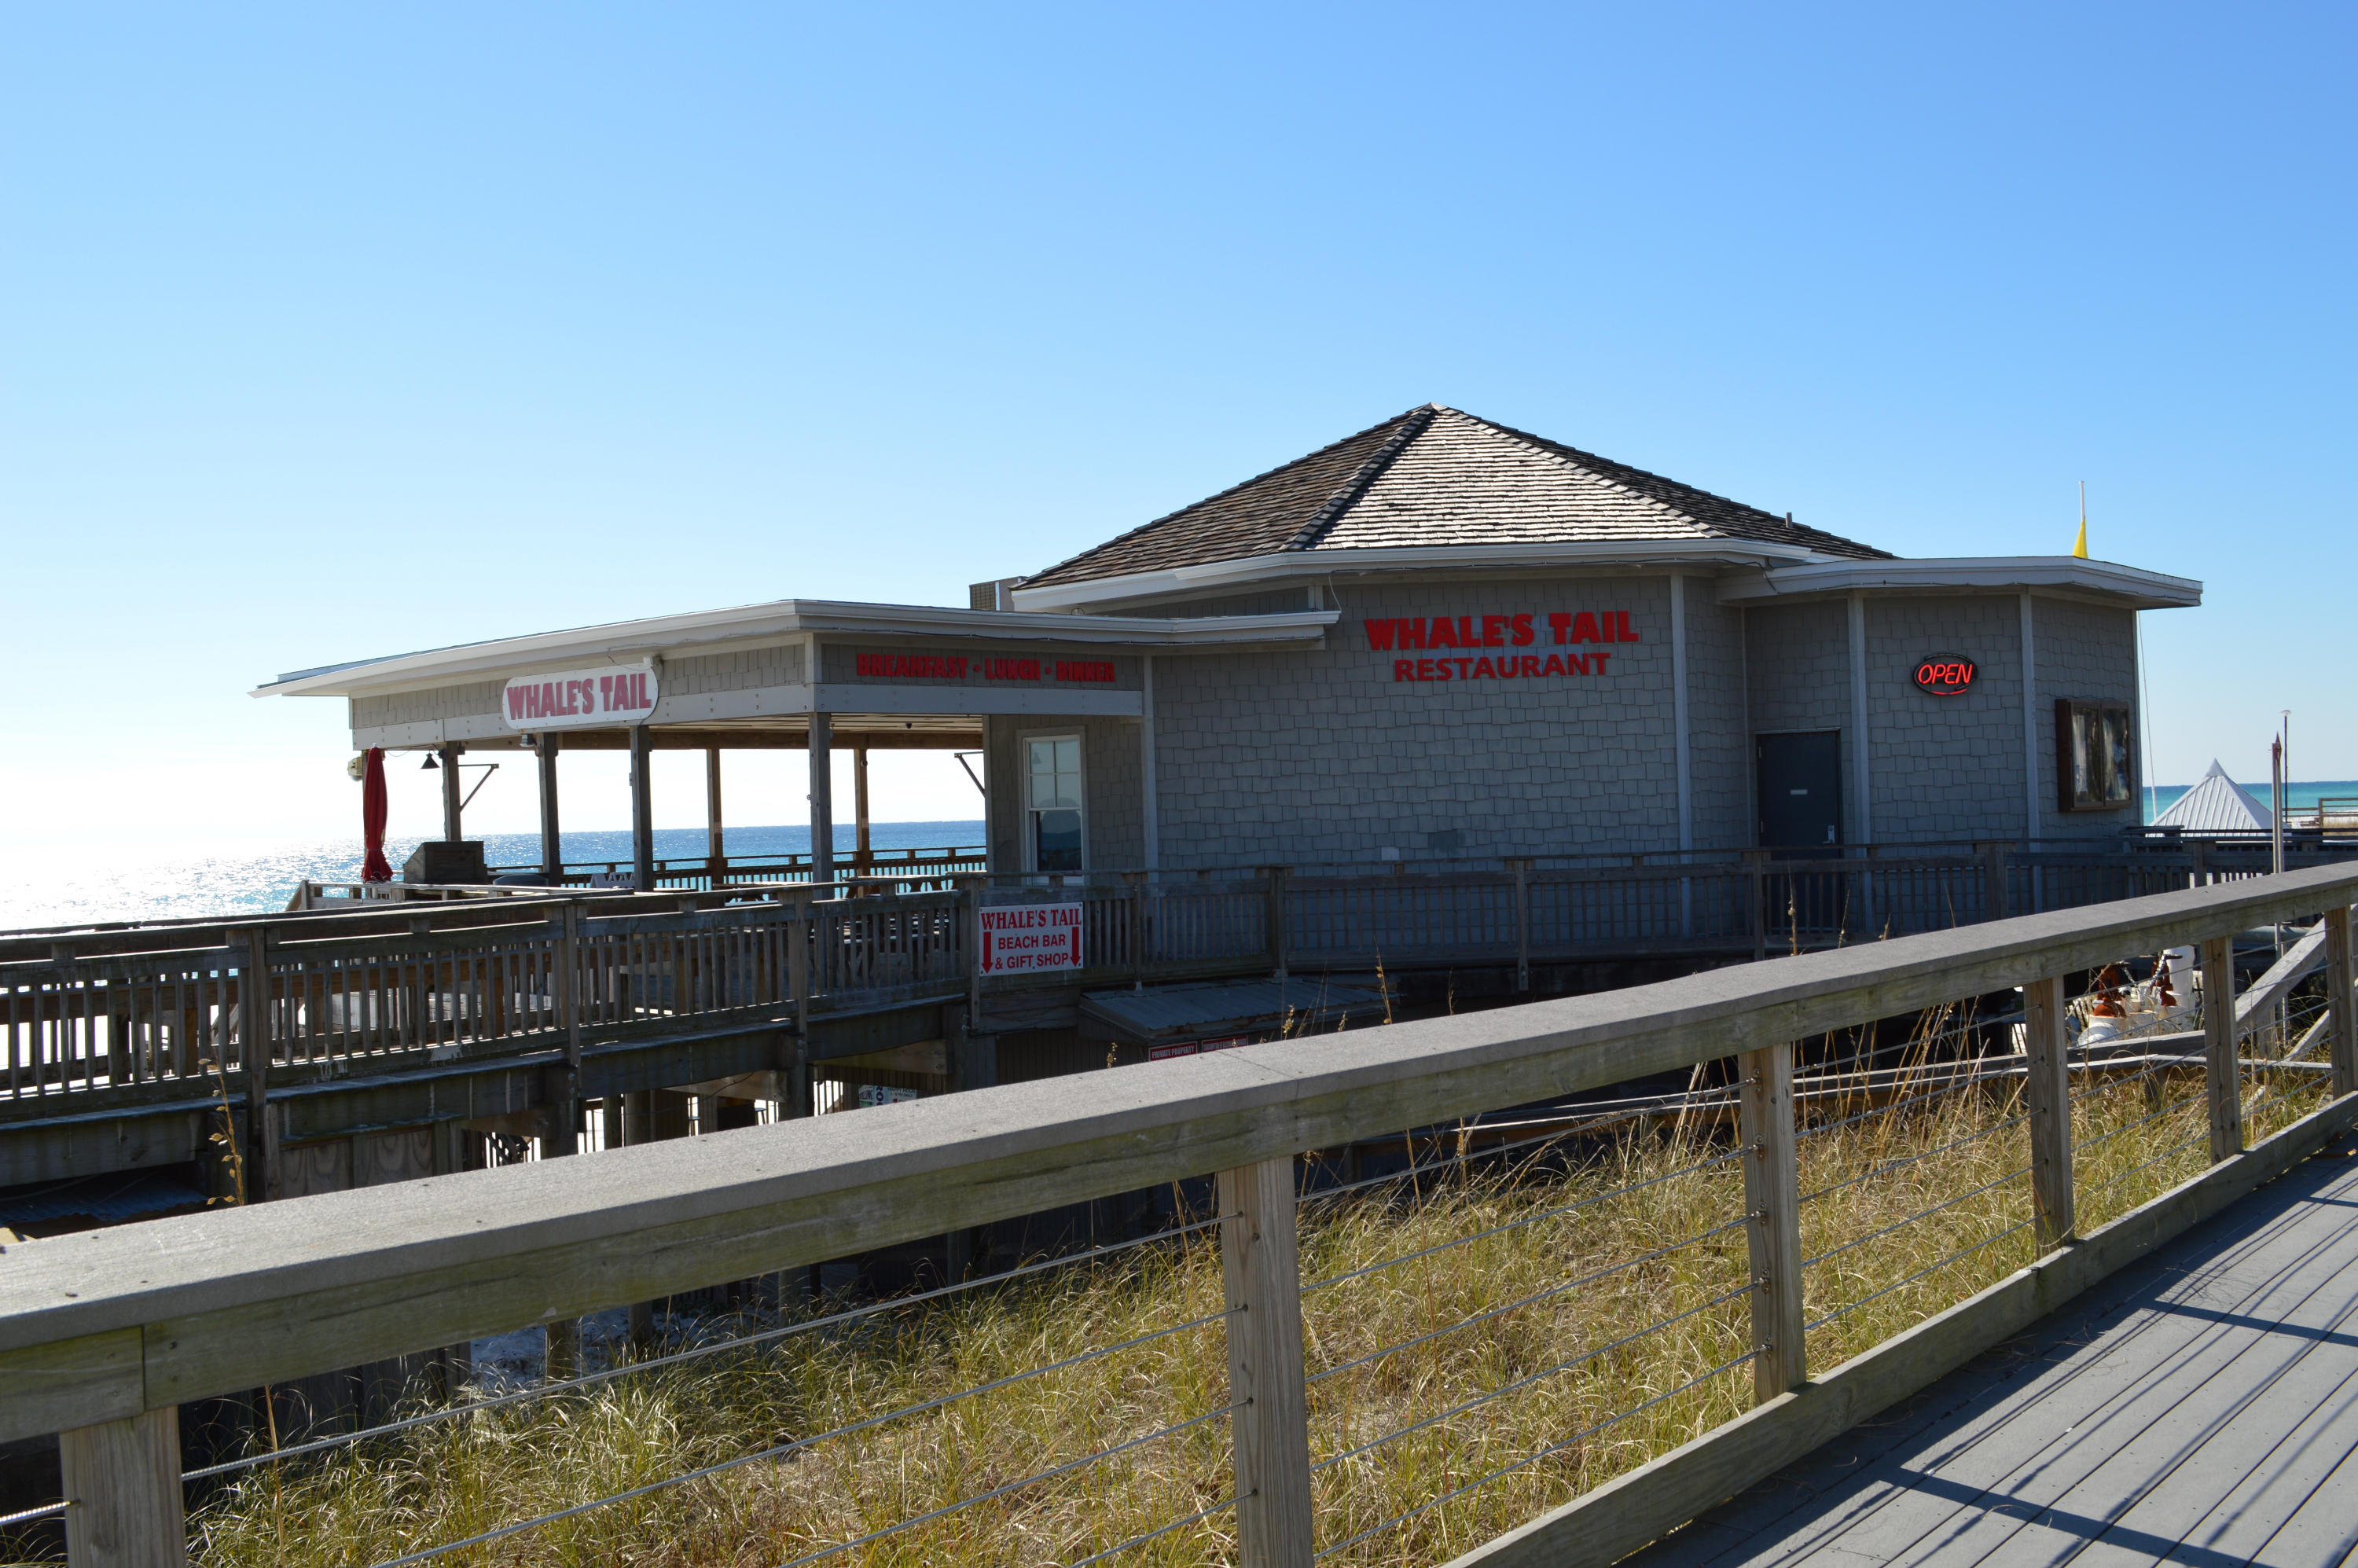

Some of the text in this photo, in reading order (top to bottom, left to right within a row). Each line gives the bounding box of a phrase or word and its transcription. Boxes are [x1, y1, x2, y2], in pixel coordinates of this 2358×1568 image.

[1364, 610, 1639, 651] WHALE'S TAIL
[856, 653, 1116, 682] BREAKFAST LUNCH DINNER
[1394, 652, 1611, 682] RESTAURANT
[1918, 663, 1973, 685] OPEN
[506, 672, 652, 720] WHALE'S TAIL
[980, 908, 1082, 931] WHALE'S TAIL
[997, 934, 1067, 950] BEACH BAR
[994, 953, 1069, 970] & GIFT SHOP
[1151, 1049, 1171, 1059] PRIVATE
[1171, 1045, 1196, 1056] PROPERTY
